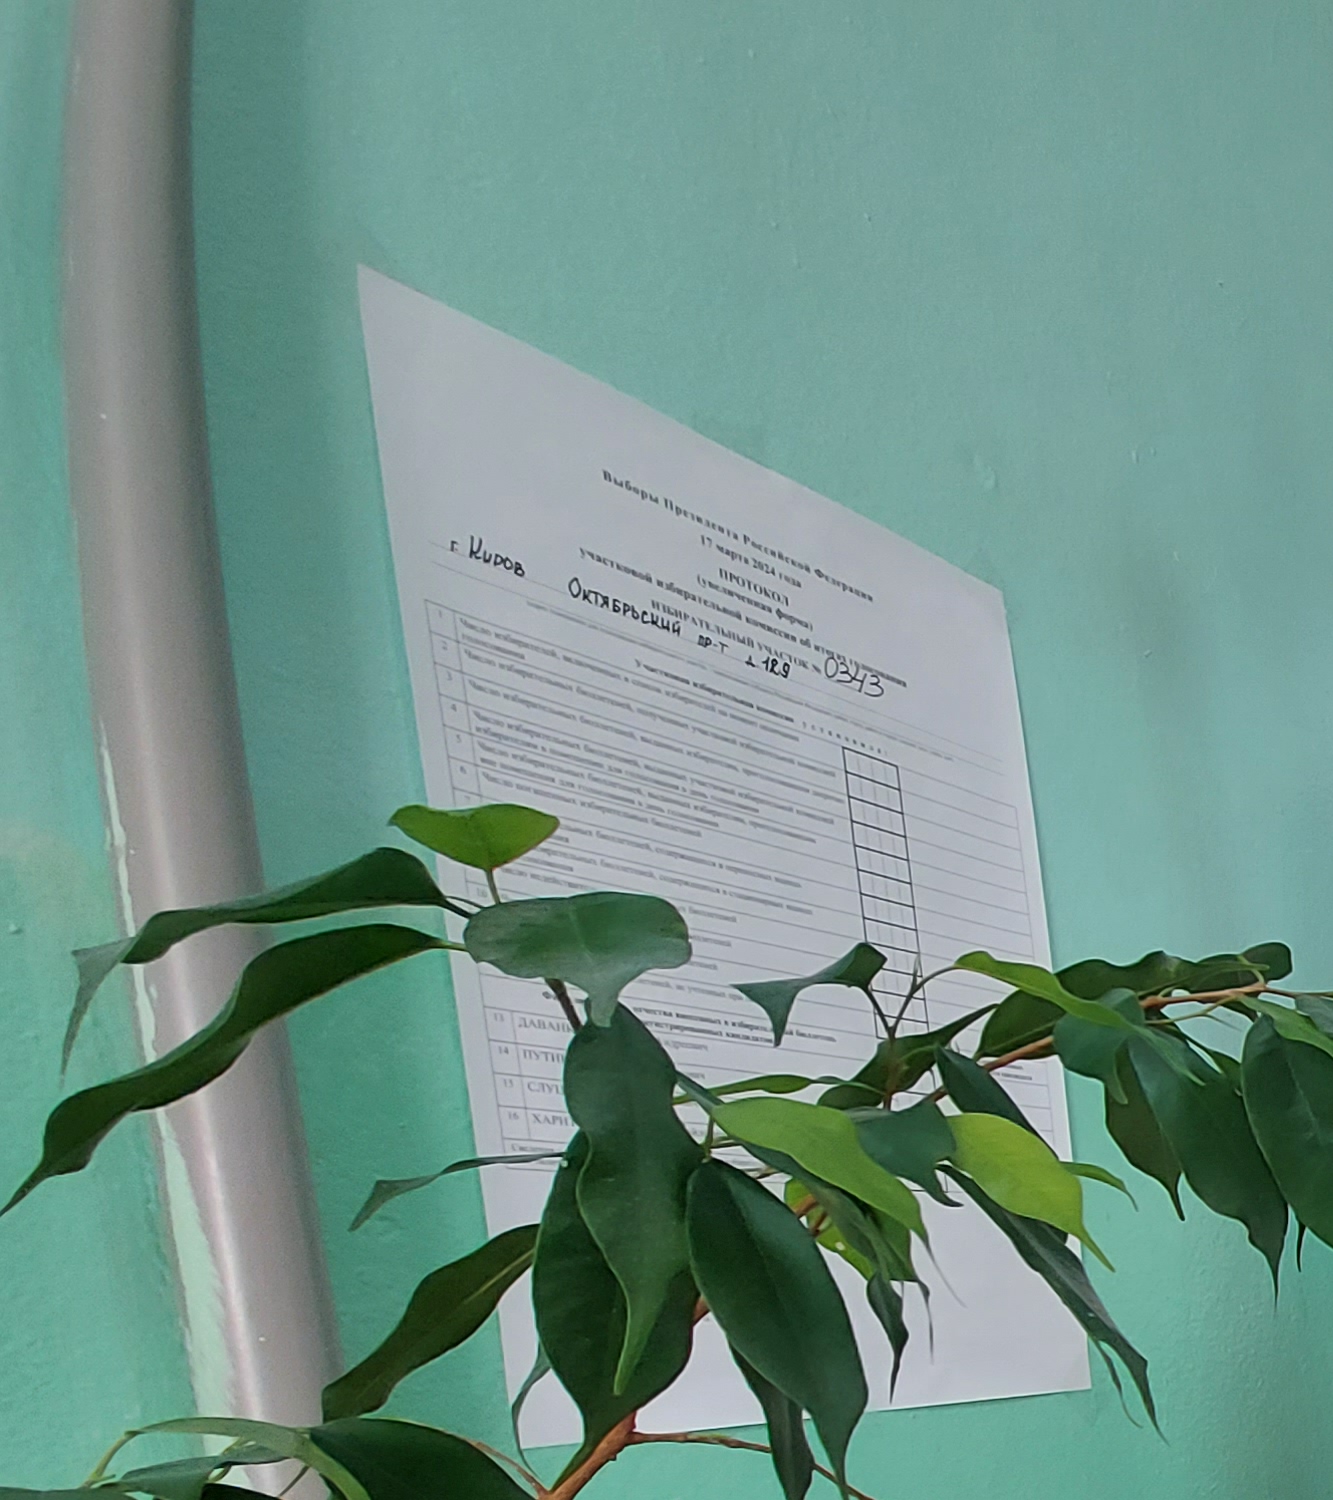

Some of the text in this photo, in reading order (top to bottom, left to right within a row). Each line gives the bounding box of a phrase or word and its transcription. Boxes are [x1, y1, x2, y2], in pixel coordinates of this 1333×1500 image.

[602, 469, 873, 603] Выборы Президента Российской Федерации
[700, 534, 801, 589] 17 марта 2024 года
[466, 532, 526, 579] Киров
[760, 652, 792, 681] 129
[579, 545, 652, 586] участковой
[655, 576, 742, 622] избирательной
[745, 615, 796, 643] комиссии
[799, 635, 811, 649] об
[696, 574, 813, 633] (увеличенная форма)
[719, 567, 789, 607] ПРОТОКОЛ
[650, 598, 754, 648] ИЗБИРАТЕЛЬНЫЙ
[758, 641, 810, 670] УЧАСТОК
[822, 652, 885, 702] 0343
